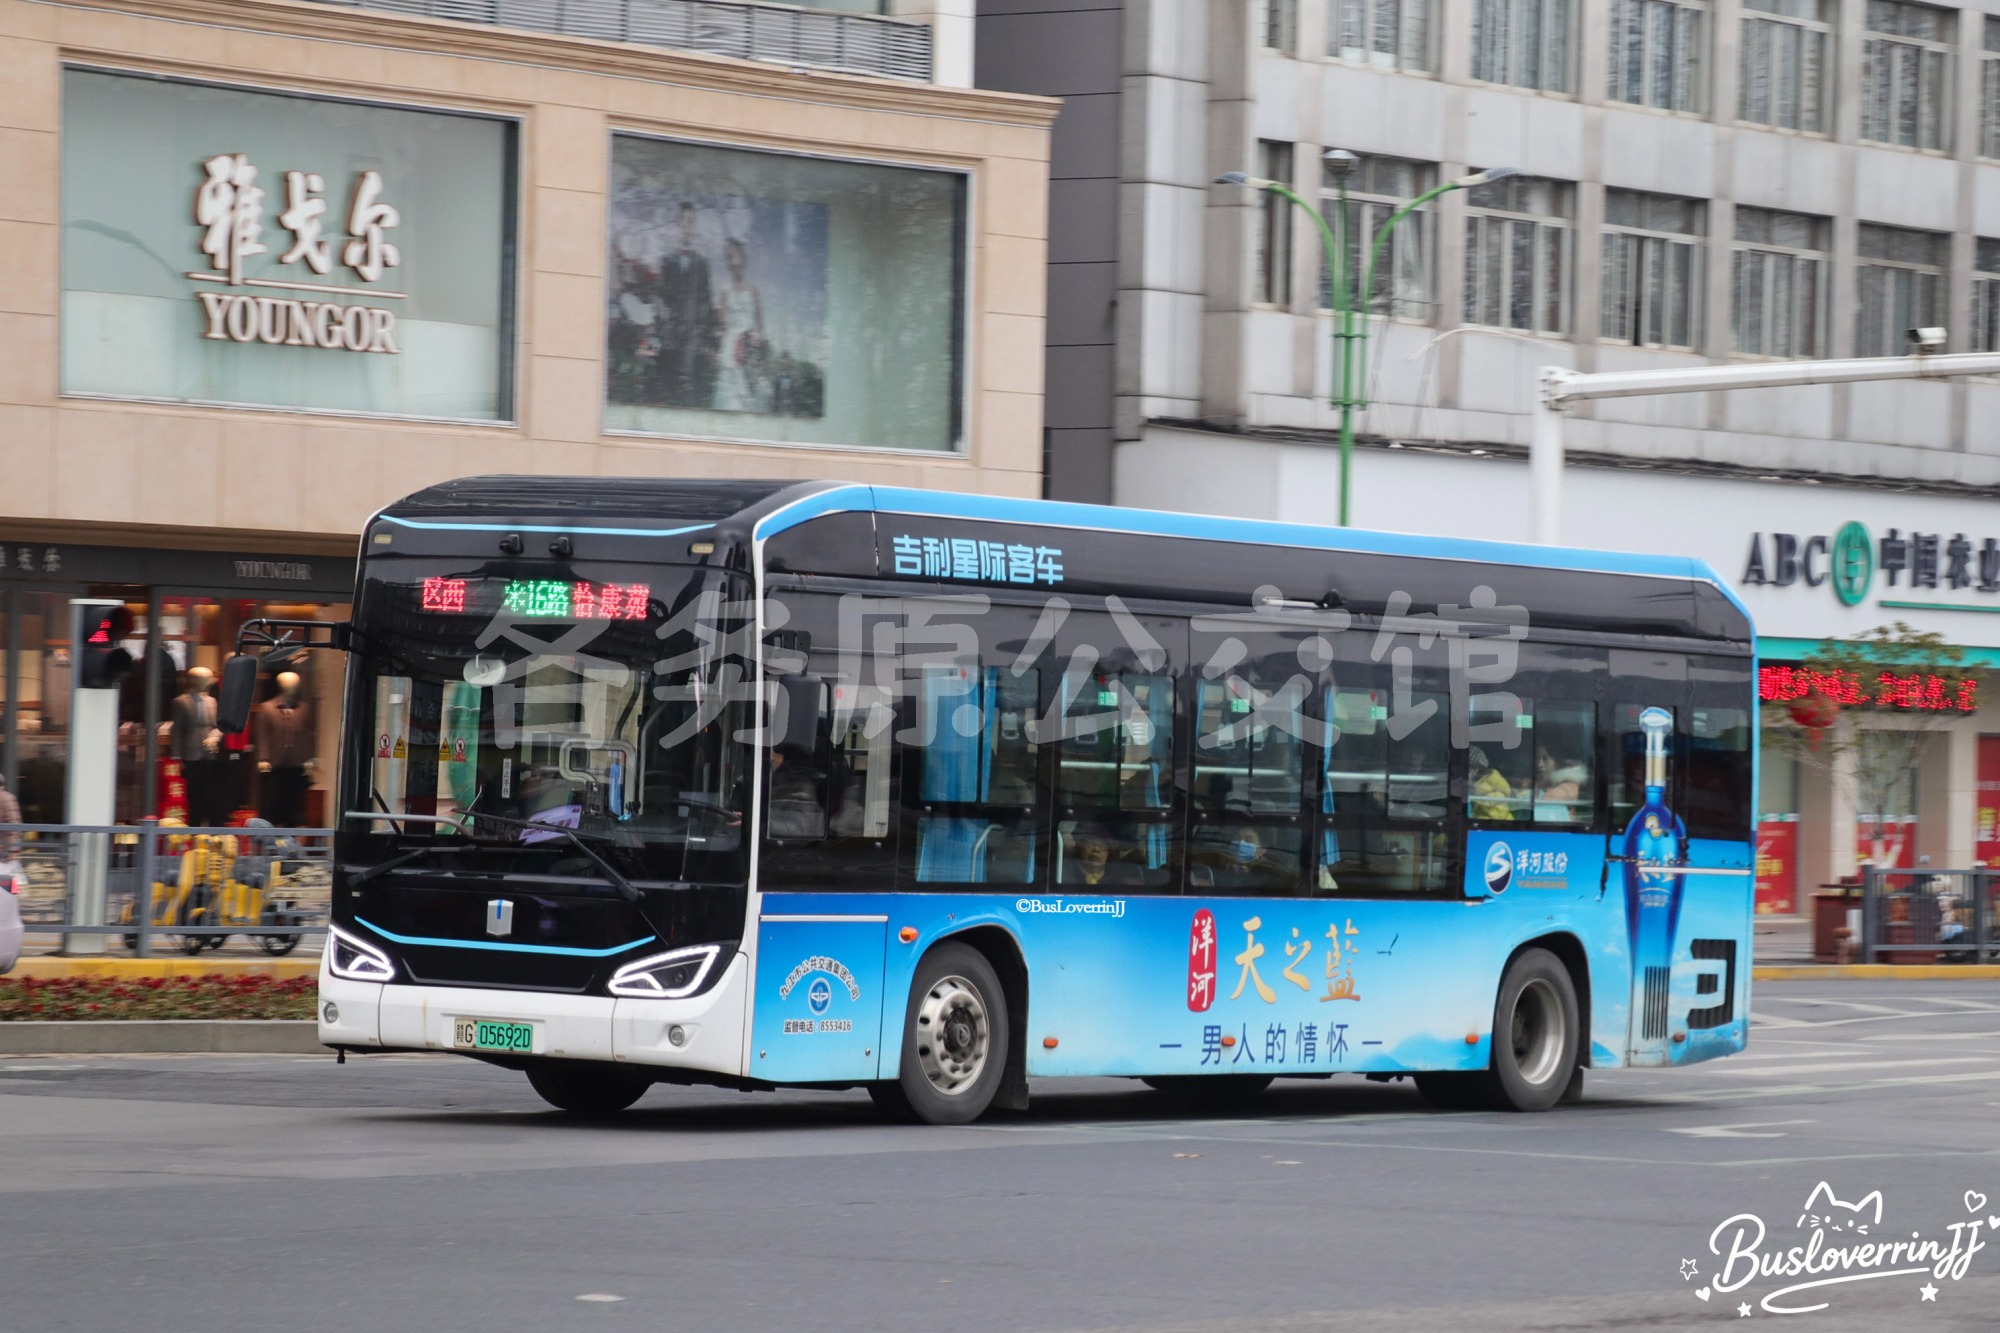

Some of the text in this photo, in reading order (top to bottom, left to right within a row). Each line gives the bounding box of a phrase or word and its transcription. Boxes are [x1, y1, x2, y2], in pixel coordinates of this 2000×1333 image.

[196, 153, 401, 285] 雅戈尔
[200, 292, 402, 354] YOUNGOR
[893, 534, 1064, 585] 吉利星际客车
[1743, 532, 1829, 588] ABC
[1190, 915, 1215, 1009] 洋河
[479, 1024, 531, 1048] 05692D
